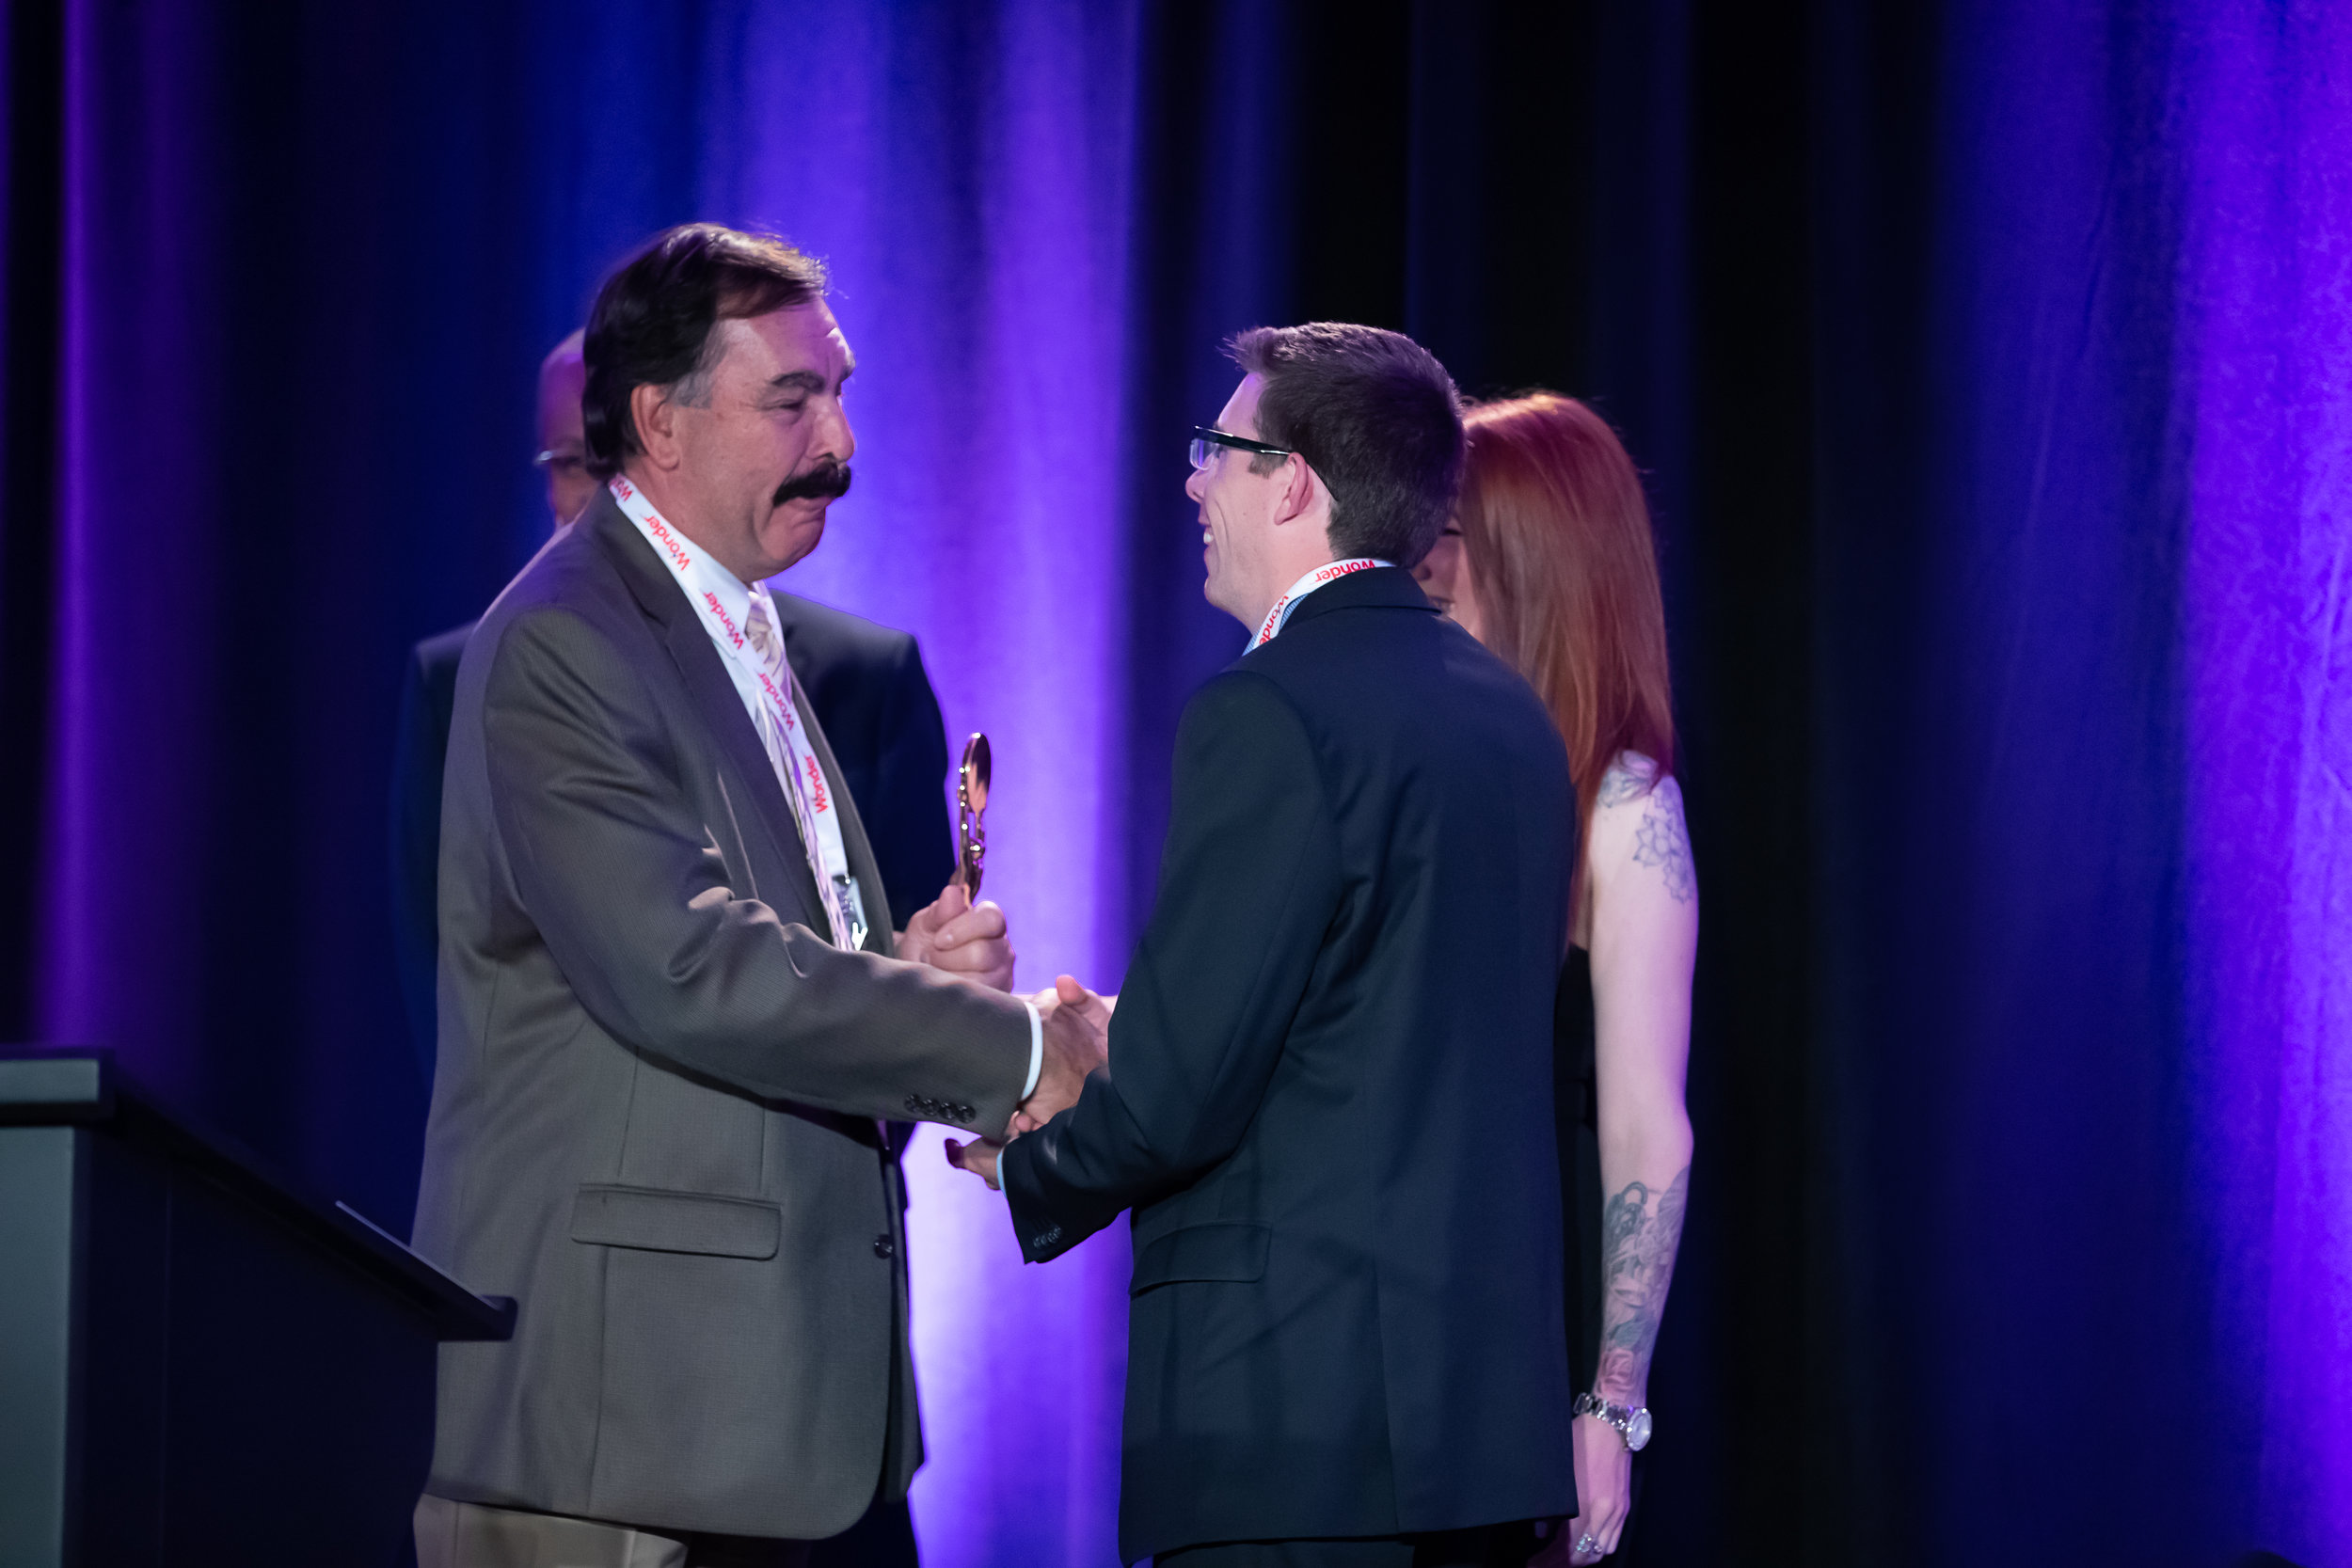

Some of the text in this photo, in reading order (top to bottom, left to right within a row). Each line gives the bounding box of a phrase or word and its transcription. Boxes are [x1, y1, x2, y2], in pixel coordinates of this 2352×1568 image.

[644, 515, 691, 571] Wonder
[1314, 560, 1375, 582] Wonder
[704, 592, 744, 650] Wonder
[1259, 595, 1289, 645] Wonde
[758, 673, 795, 731] Wonder
[804, 755, 829, 814] Wonder
